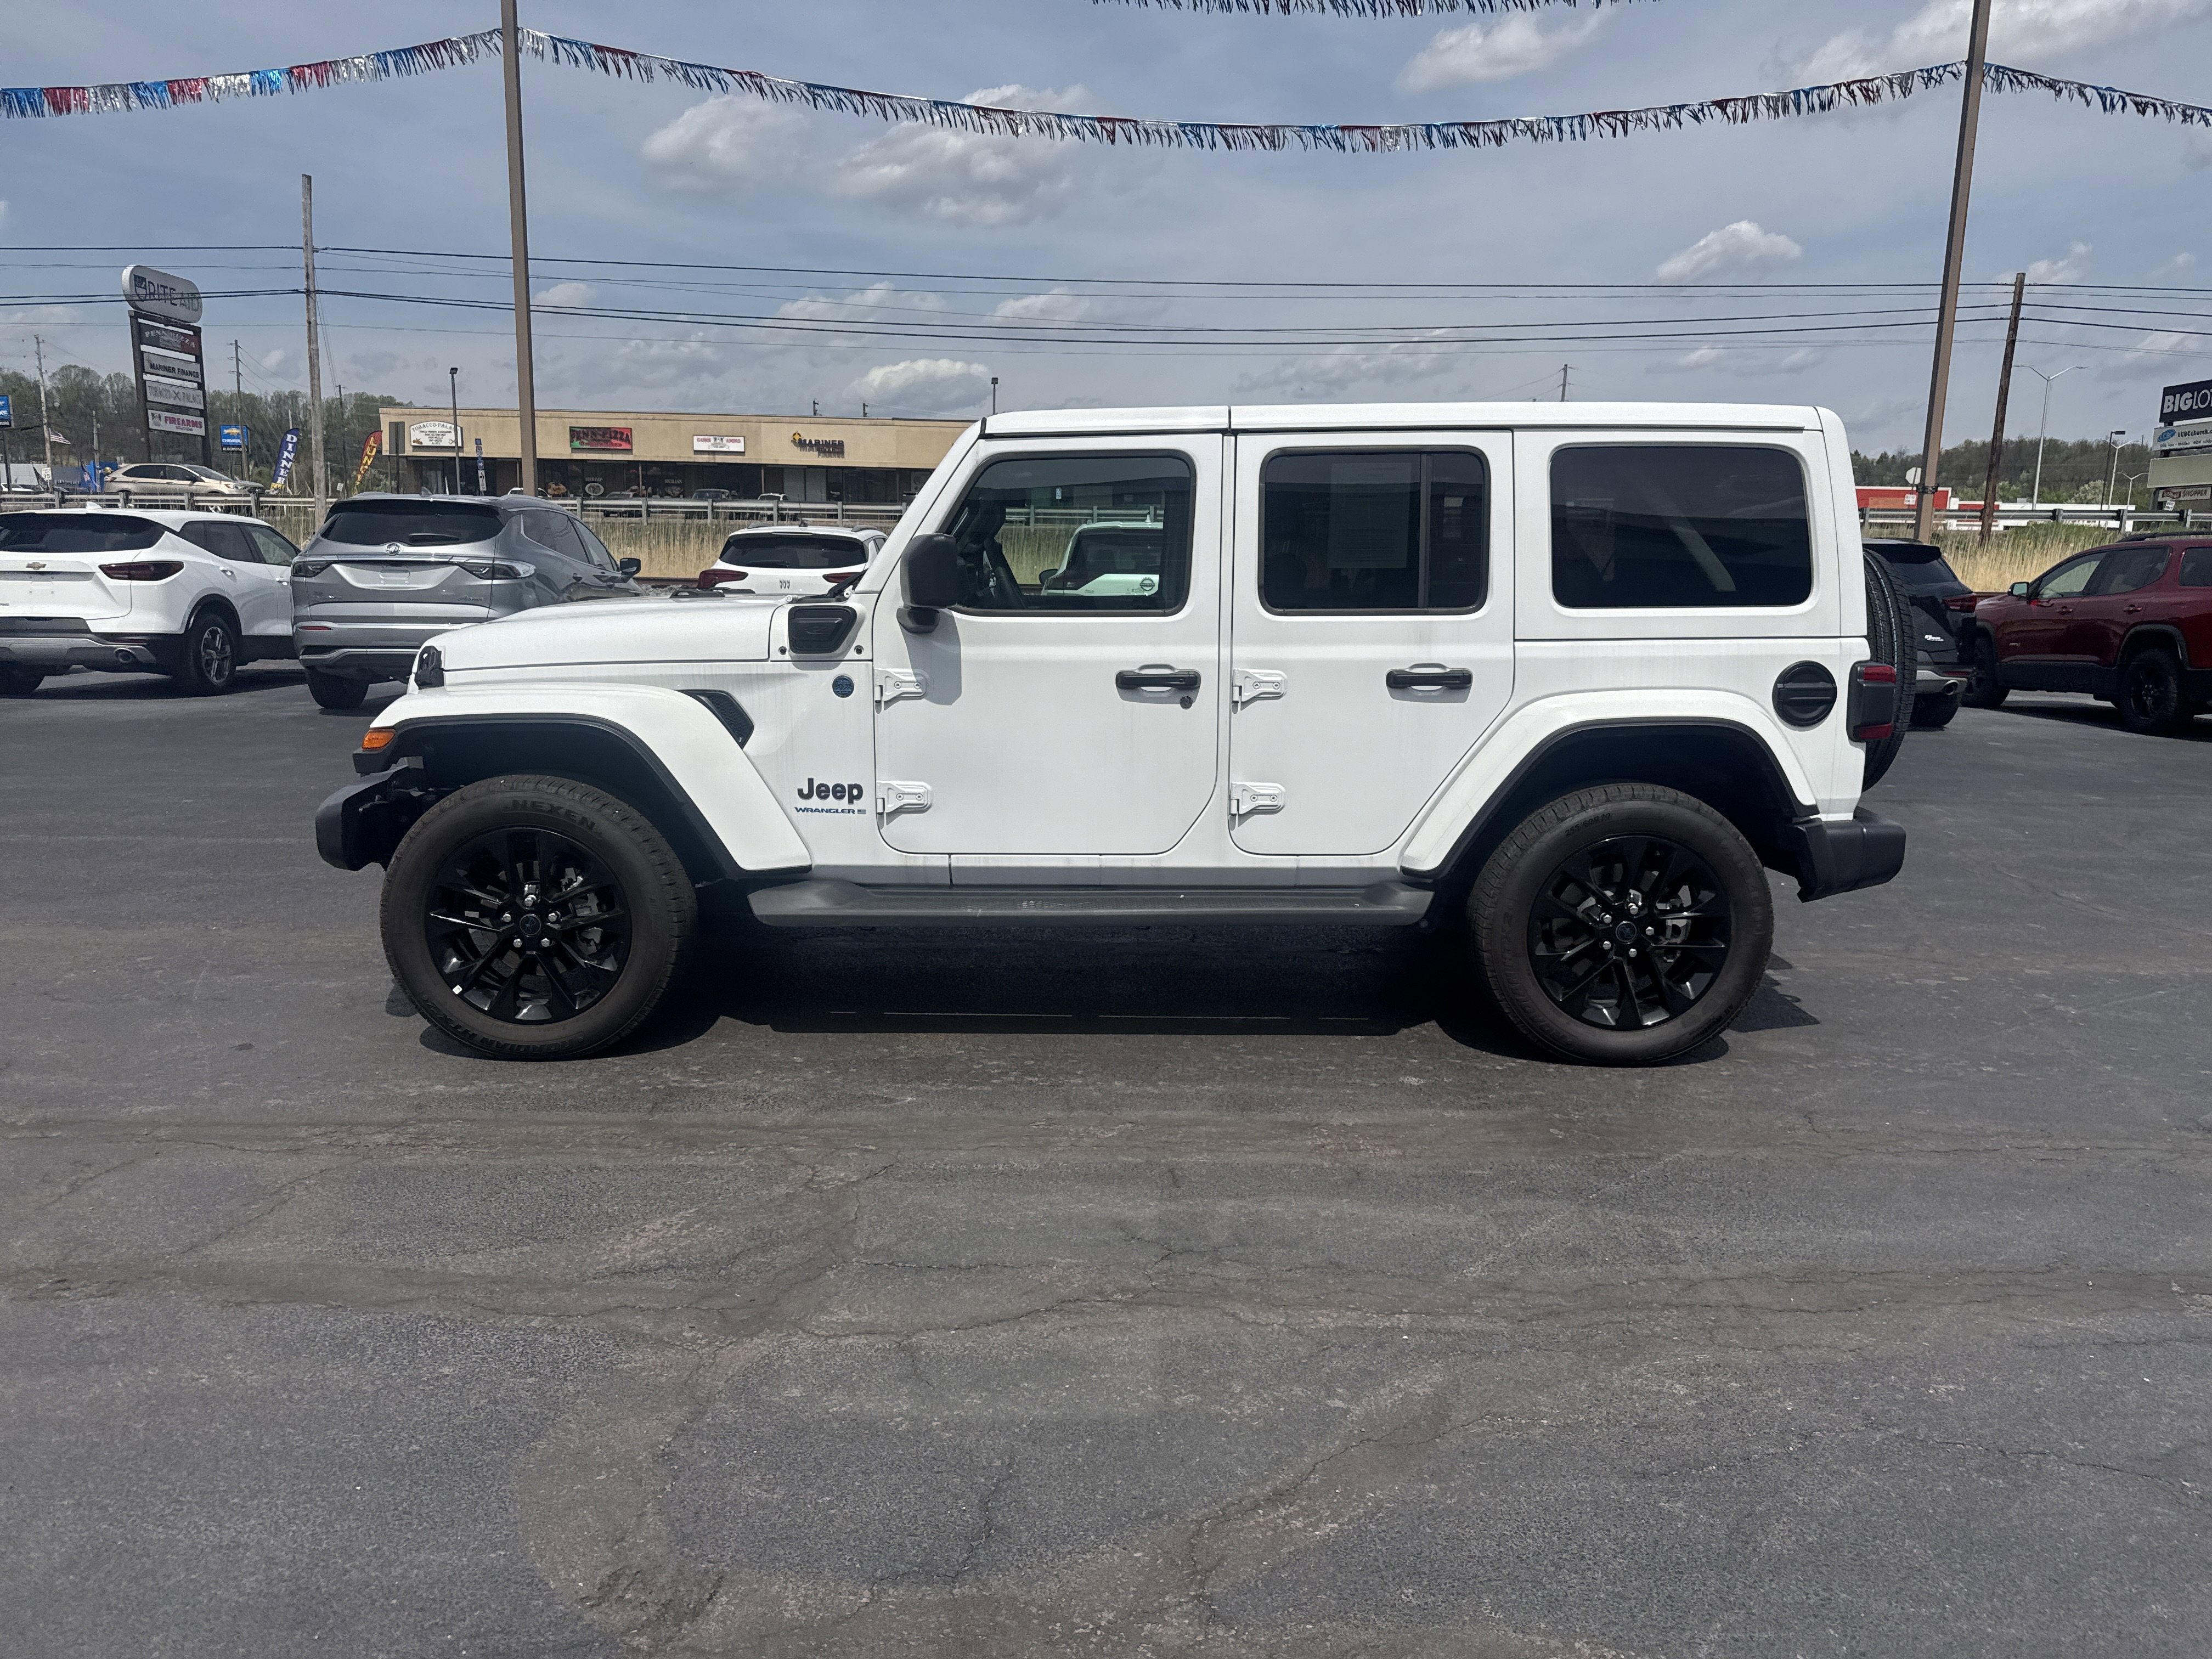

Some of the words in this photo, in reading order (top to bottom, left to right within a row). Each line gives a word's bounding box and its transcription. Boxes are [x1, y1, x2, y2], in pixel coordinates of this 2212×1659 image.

[148, 280, 177, 307] RITE
[179, 291, 200, 312] AID
[145, 330, 167, 338] PENN
[150, 363, 176, 374] MARINER
[177, 368, 200, 379] FINANCE
[165, 415, 202, 428] FIREARMS
[411, 423, 436, 432] TOBACCO
[438, 423, 459, 432] PALAC
[276, 434, 297, 484] DINNER
[797, 777, 863, 805] Jeep
[512, 799, 596, 830] NEXEN
